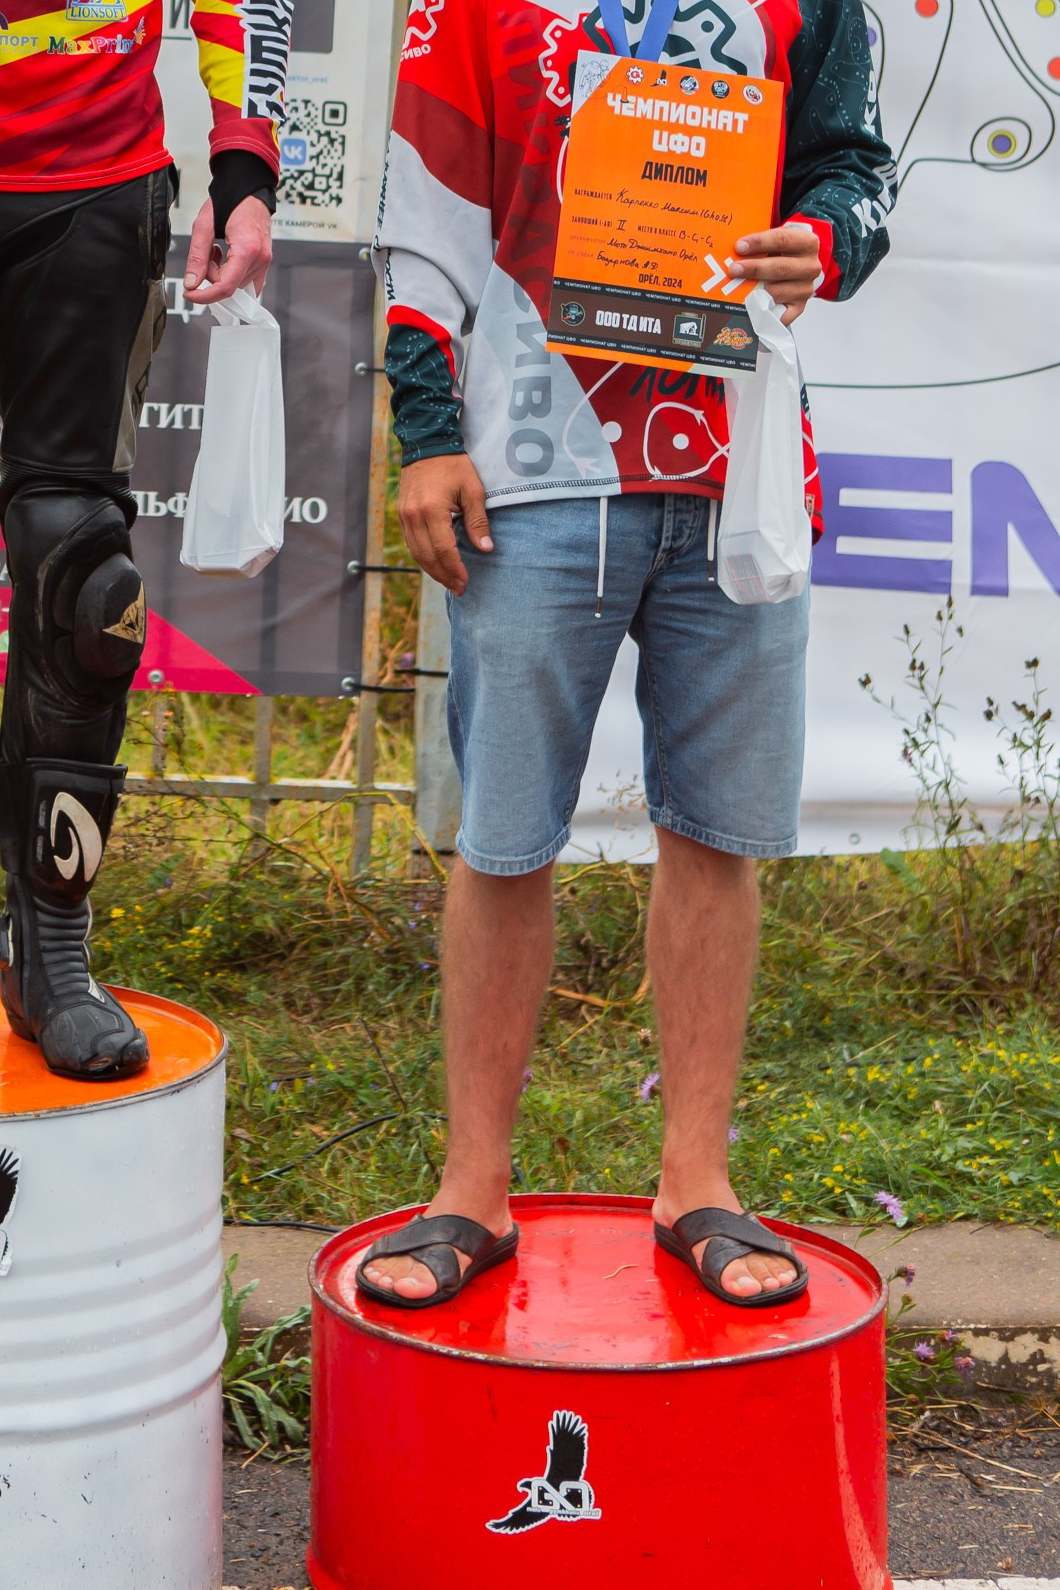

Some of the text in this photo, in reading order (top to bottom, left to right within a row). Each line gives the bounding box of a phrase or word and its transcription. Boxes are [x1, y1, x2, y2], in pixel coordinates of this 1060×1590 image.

[70, 5, 126, 19] LIONSOFT
[607, 92, 749, 134] ЧЕМПИОНАТ
[652, 129, 706, 158] ЦФО
[641, 160, 708, 188] ДИПЛОМ
[662, 276, 683, 289] 2024
[595, 309, 662, 335] ООО ТД ИТА
